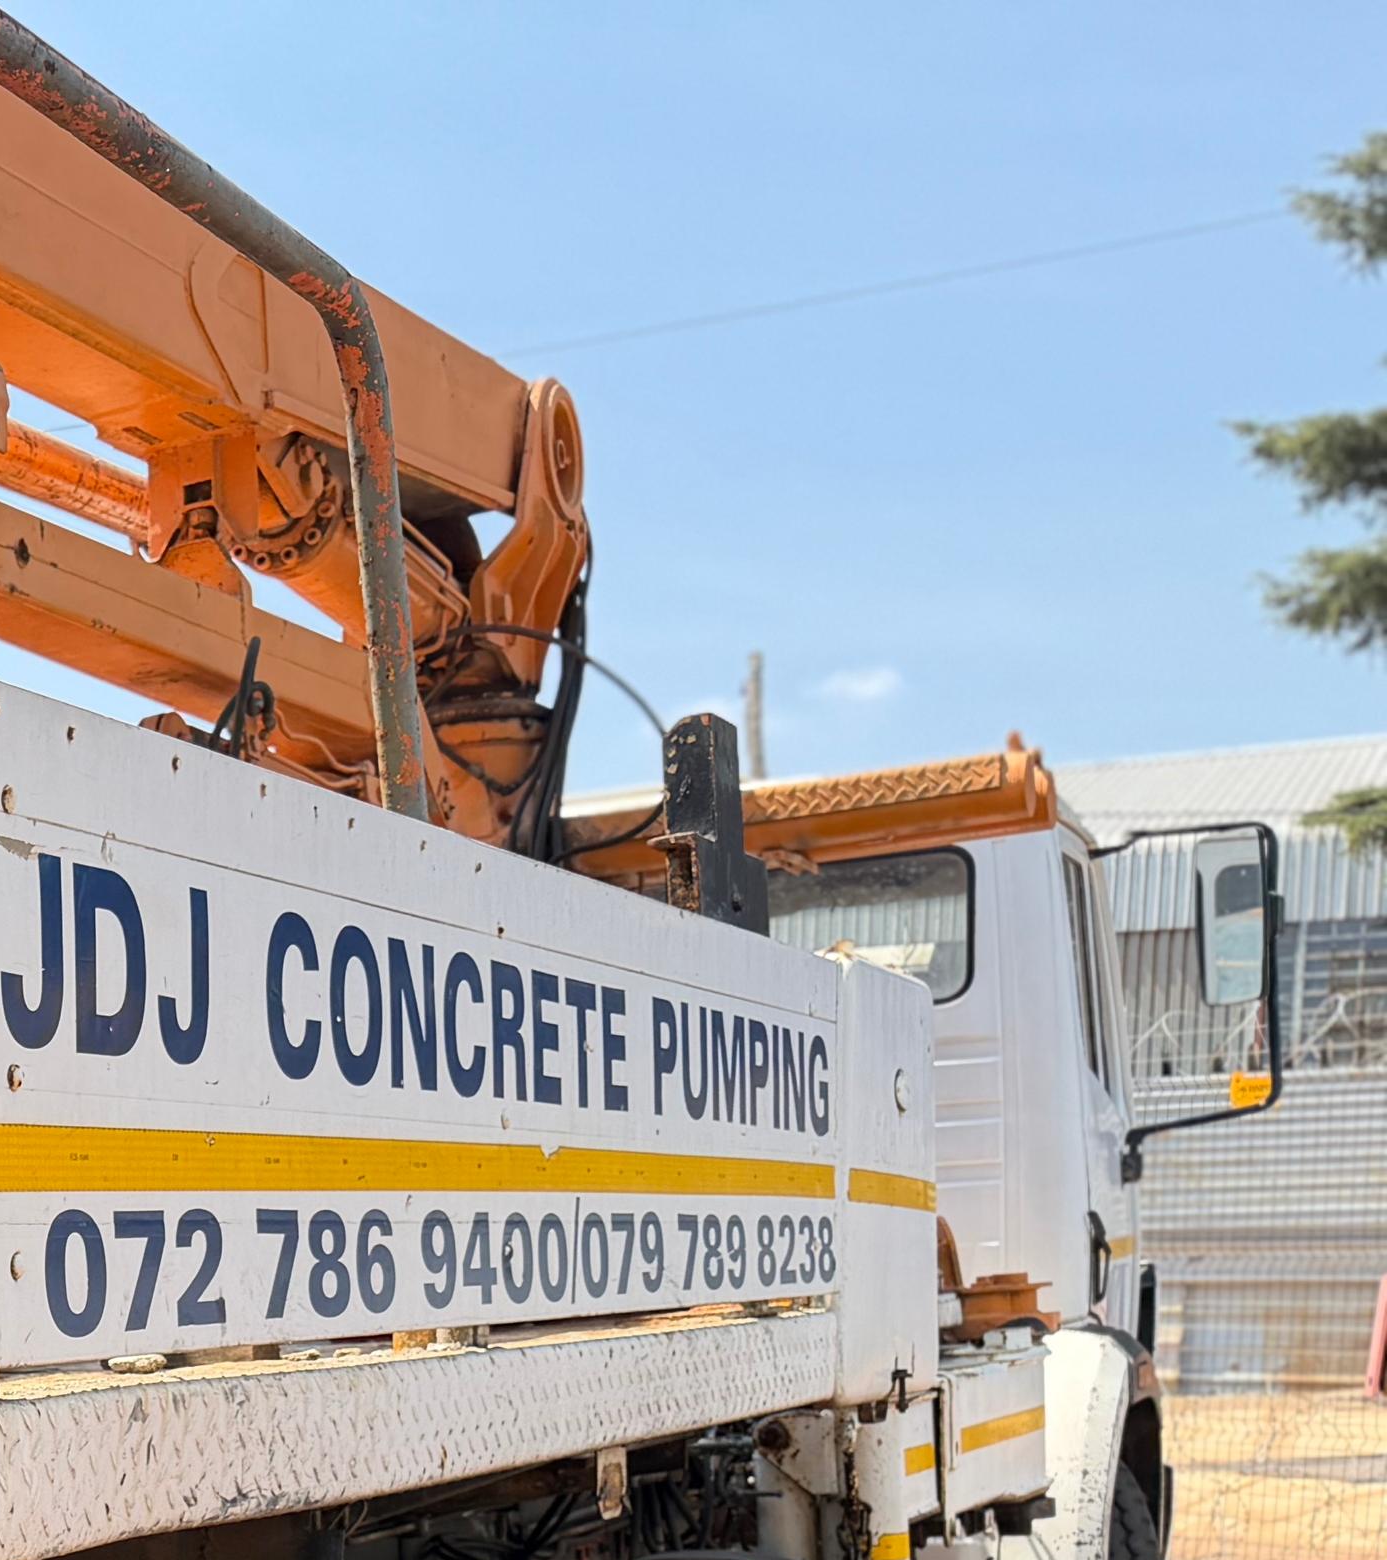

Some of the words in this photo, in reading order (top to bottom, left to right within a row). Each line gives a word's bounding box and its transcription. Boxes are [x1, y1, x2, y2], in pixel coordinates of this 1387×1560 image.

[1, 852, 210, 1065] JDJ
[265, 911, 629, 1112] CONCRETE
[651, 996, 832, 1137] PUMPING
[44, 1208, 227, 1337] 072
[255, 1208, 396, 1320] 786
[420, 1196, 665, 1310] 9400/079
[677, 1212, 747, 1291] 789
[757, 1214, 838, 1287] 8238
